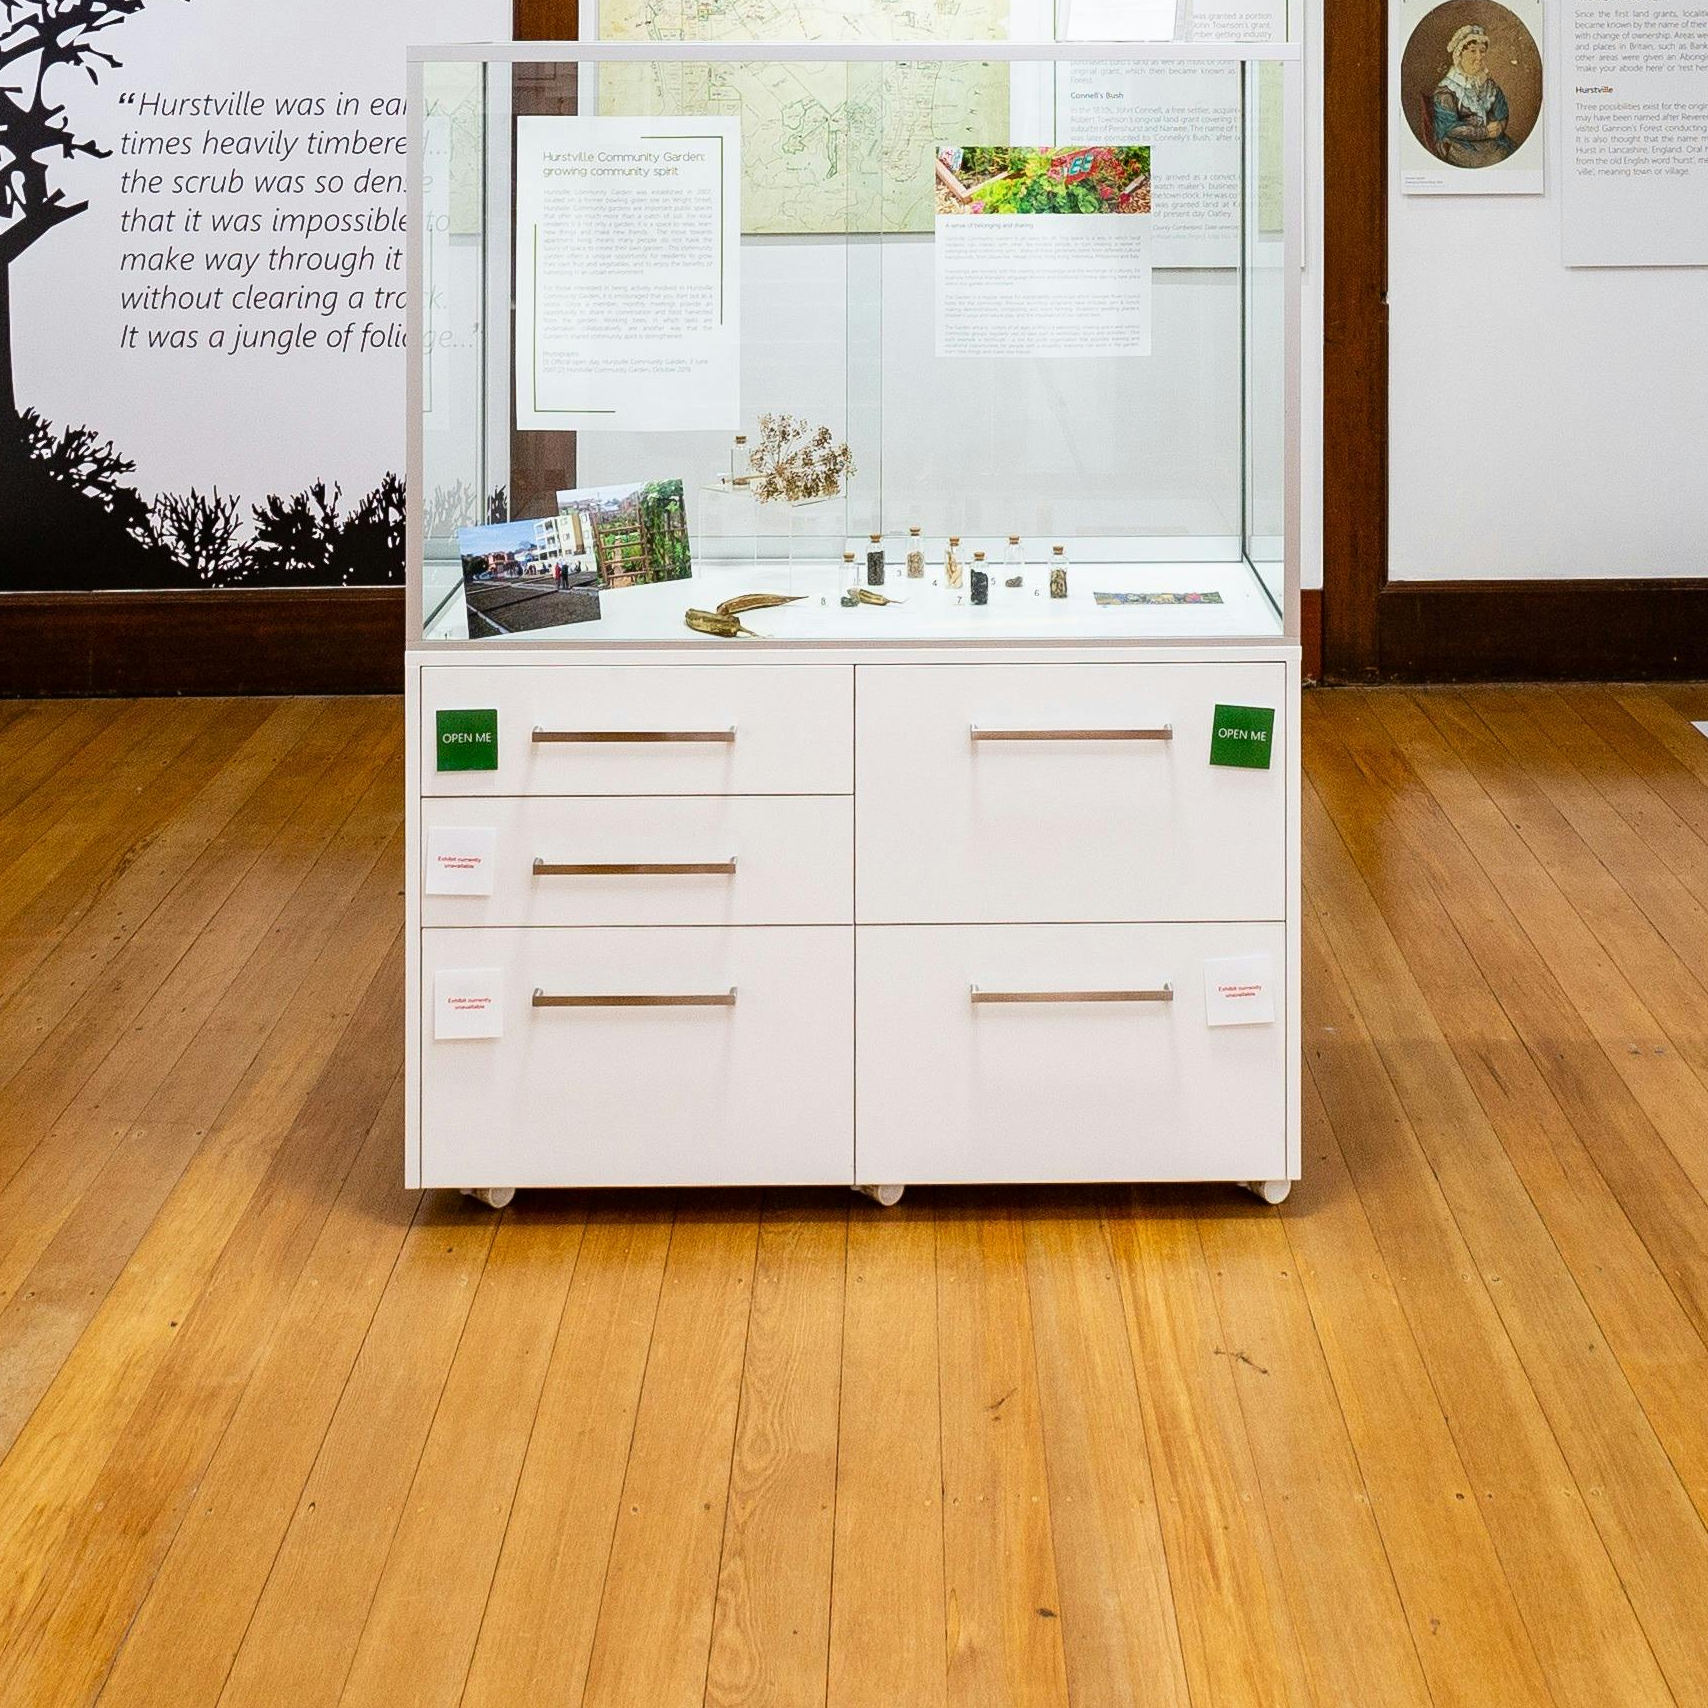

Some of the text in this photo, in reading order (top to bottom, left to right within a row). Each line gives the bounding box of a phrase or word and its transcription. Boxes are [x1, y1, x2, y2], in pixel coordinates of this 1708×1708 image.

[275, 96, 326, 117] was
[336, 91, 360, 117] in
[120, 132, 193, 156] times
[201, 129, 299, 161] heavily
[597, 151, 661, 165] Community
[120, 169, 163, 195] the
[171, 169, 244, 195] scrub
[253, 174, 305, 195] was
[315, 174, 344, 195] so
[120, 208, 176, 233] that
[183, 208, 203, 233] it
[210, 213, 262, 233] was
[272, 207, 408, 239] impossible
[120, 247, 403, 278] make way through it
[120, 285, 223, 311] without
[232, 285, 338, 317] clearing
[347, 291, 364, 311] a
[120, 324, 139, 349] It
[147, 330, 199, 349] was
[208, 330, 224, 349] a
[228, 323, 316, 356] jungle
[326, 322, 356, 355] of
[442, 731, 492, 745] OPEN ME
[1217, 727, 1267, 742] OPEN ME
